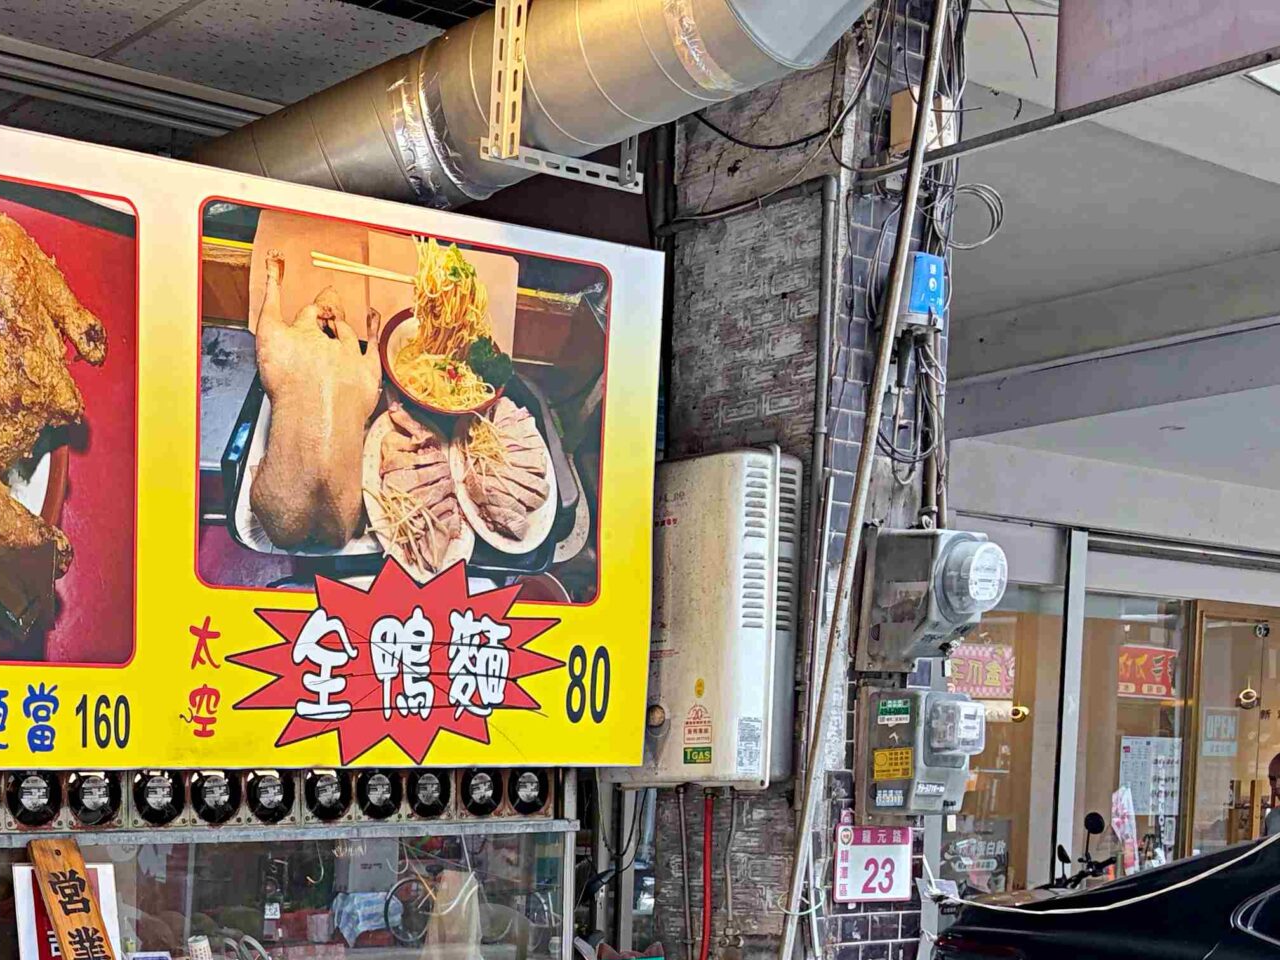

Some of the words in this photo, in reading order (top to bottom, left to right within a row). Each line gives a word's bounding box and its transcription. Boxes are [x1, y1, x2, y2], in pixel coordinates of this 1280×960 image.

[189, 615, 221, 738] 太空
[291, 604, 513, 721] 全鴨麵
[565, 645, 610, 724] 80
[861, 857, 895, 894] 23
